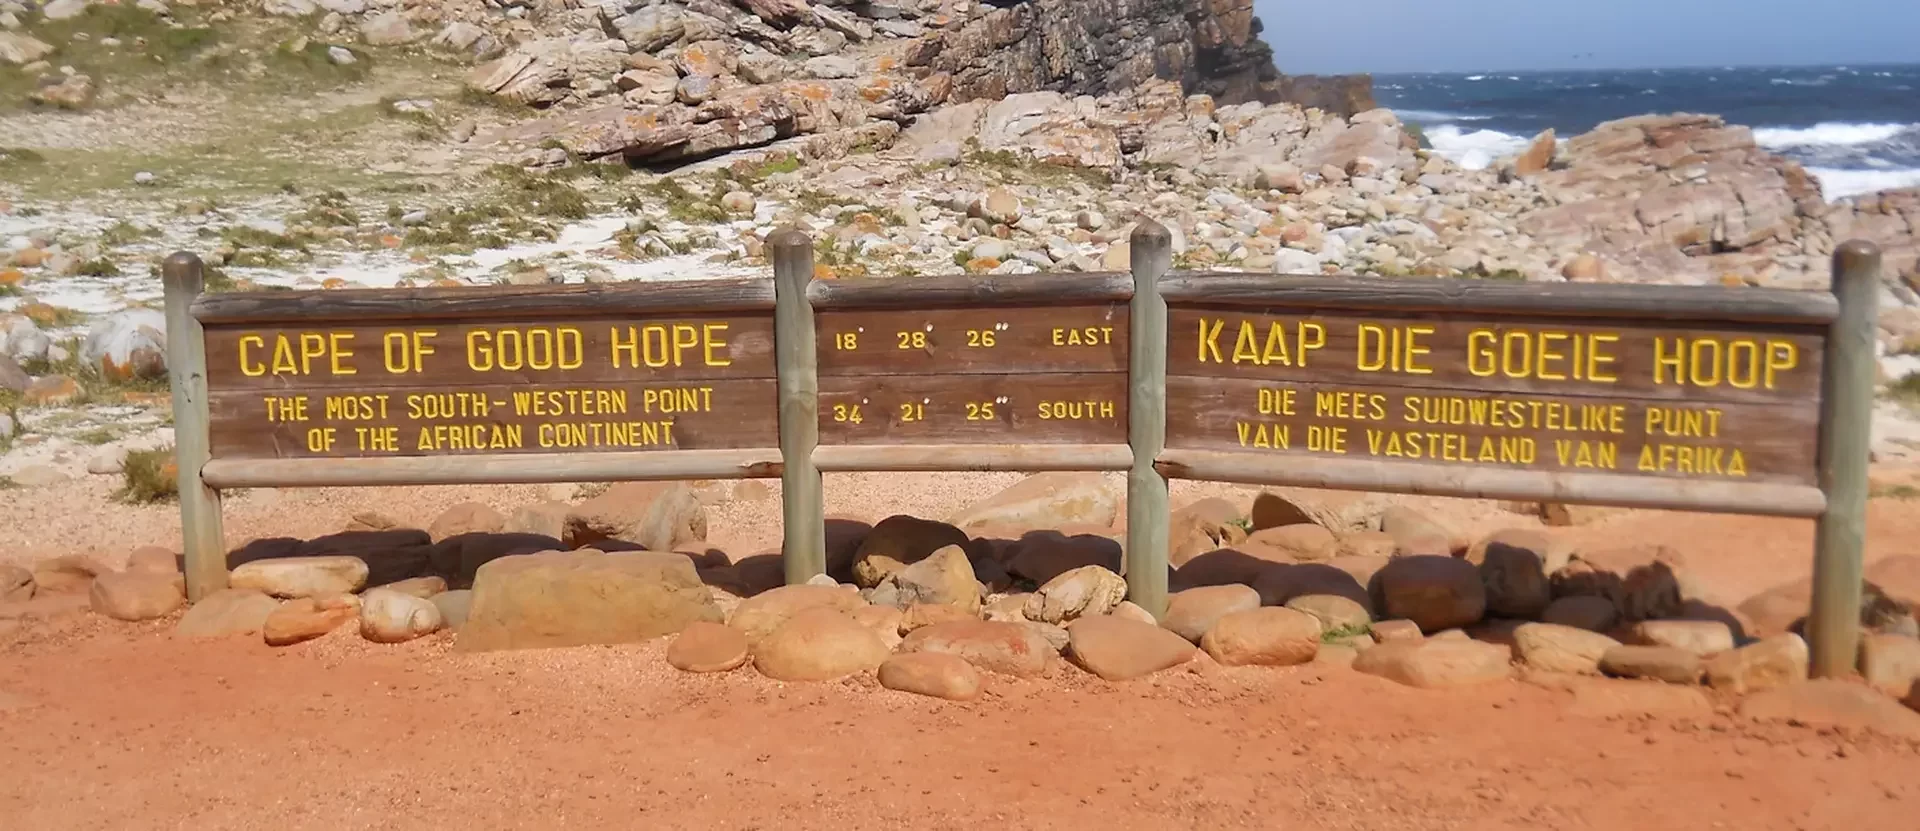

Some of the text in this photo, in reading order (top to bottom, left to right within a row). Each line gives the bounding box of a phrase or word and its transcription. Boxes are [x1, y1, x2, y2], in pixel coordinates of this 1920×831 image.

[238, 323, 733, 377] CAPE OF GOOD HOPE
[1052, 326, 1113, 346] EAST
[1197, 318, 1798, 389] KAAP DIE GOEIE HOOP
[264, 395, 308, 421] THE
[325, 393, 389, 420] MOST
[643, 386, 713, 414] POINT
[1038, 401, 1115, 419] SOUTH
[1257, 387, 1723, 437] DIE MEES SUIDWESTELIKE PUNT
[306, 420, 674, 452] OF THE AFRICAN CONTINENT
[1236, 421, 1747, 477] VAN DIE VASTELAND VAN AFRIKA
